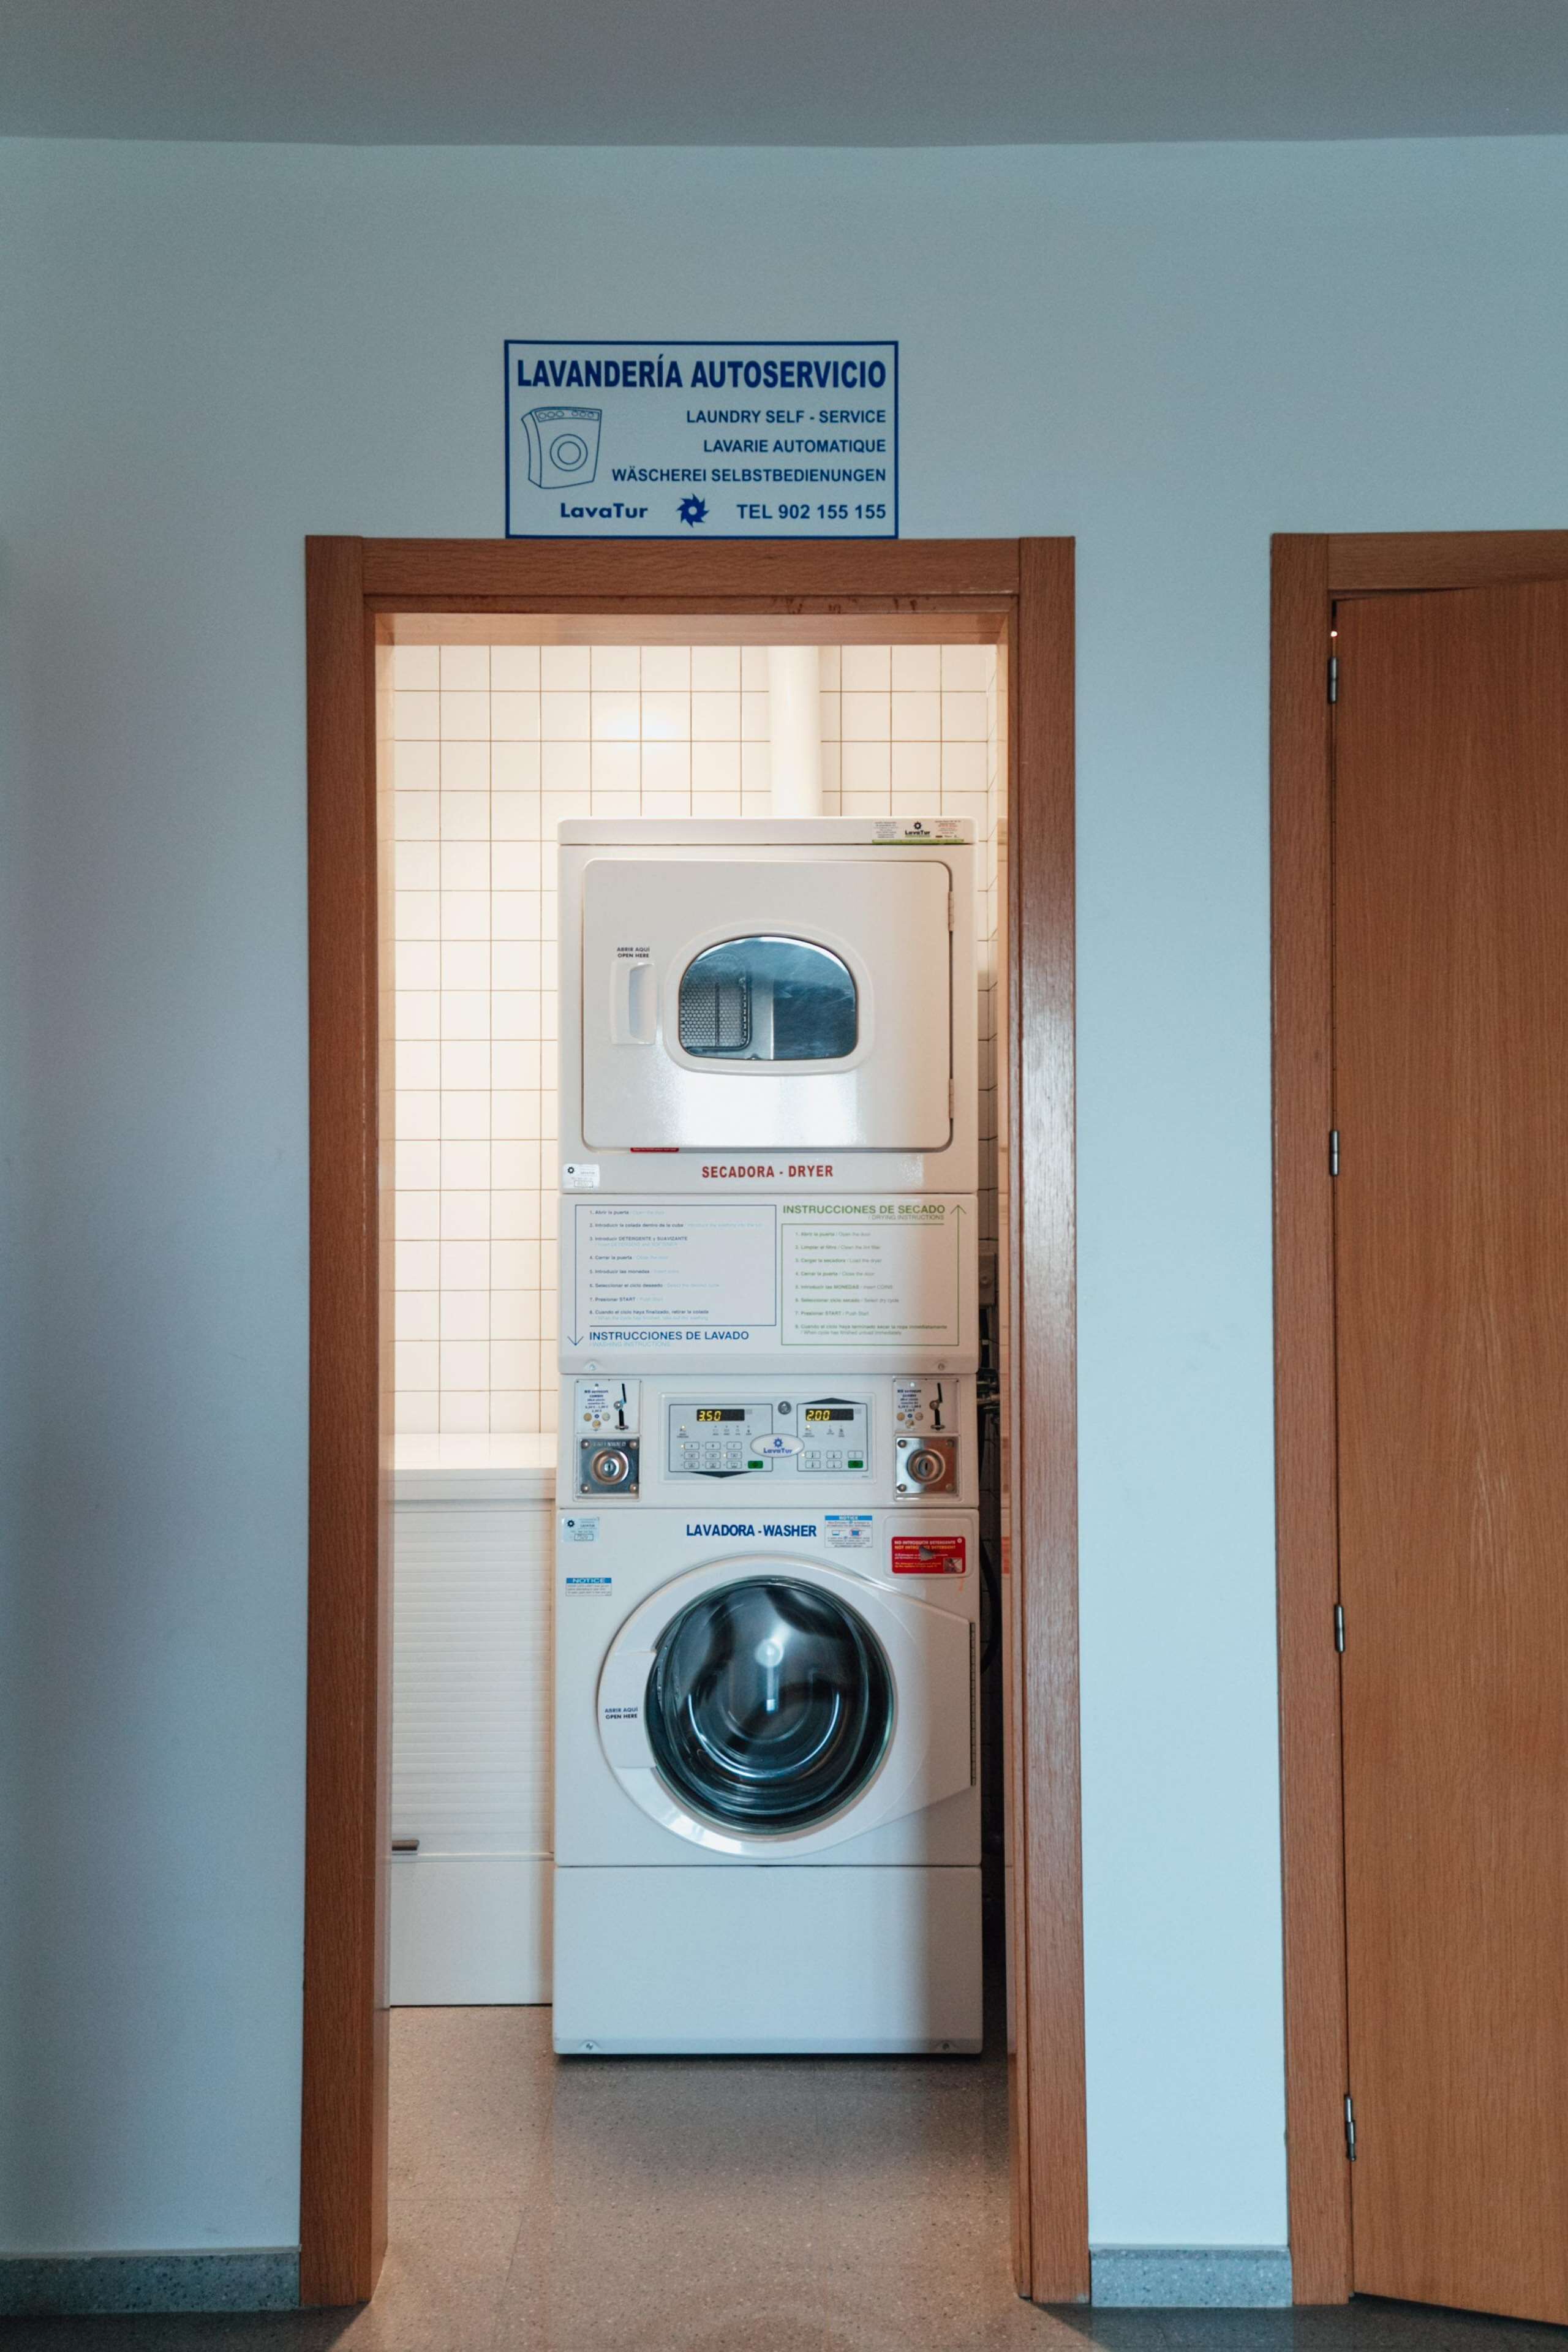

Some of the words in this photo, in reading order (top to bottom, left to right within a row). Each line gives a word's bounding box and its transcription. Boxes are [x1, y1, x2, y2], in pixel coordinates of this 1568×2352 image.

[518, 353, 683, 388] LAVANDERÍA
[691, 360, 886, 388] AUTOSERVICIO
[687, 410, 761, 423] LAUNDRY
[766, 410, 804, 423] SELF
[820, 409, 886, 424] SERVICE
[704, 439, 769, 453] LAVARIE
[773, 439, 886, 453] AUTOMATIQUE
[612, 466, 707, 482] WÄSCHEREI
[712, 468, 886, 483] SELBSTBEDIENUNGEN
[560, 502, 648, 519] LavaTur
[736, 503, 773, 519] TEL
[778, 503, 810, 519] 902
[817, 504, 848, 519] 155
[855, 503, 886, 519] 155
[702, 1166, 775, 1178] SECADORA
[788, 1166, 833, 1177] DRYER
[783, 1205, 876, 1214] INSTRUCCIONES
[880, 1205, 895, 1214] DE
[898, 1205, 945, 1214] SECADO
[590, 1332, 682, 1340] INSTRUCCIONES
[686, 1332, 701, 1340] DE
[705, 1331, 748, 1340] LAVADO
[698, 1411, 722, 1421] 3.50
[806, 1411, 830, 1421] 2.00
[686, 1524, 755, 1537] LAVADORA
[763, 1524, 817, 1537] WASHER
